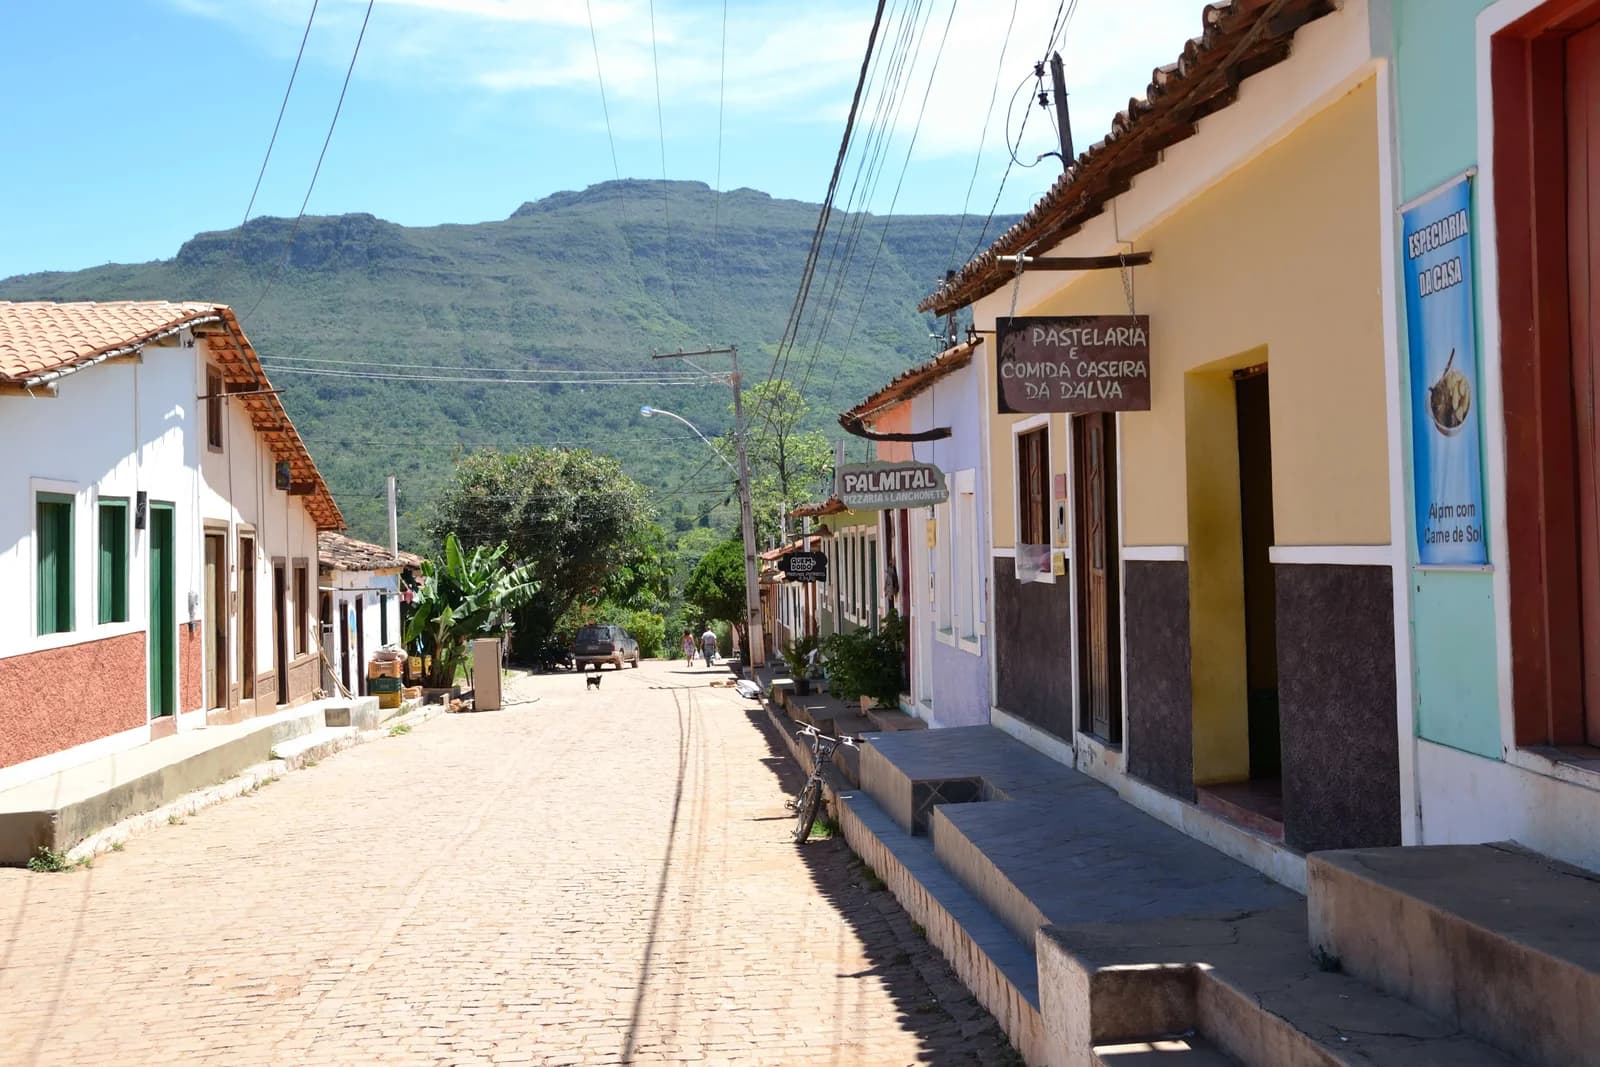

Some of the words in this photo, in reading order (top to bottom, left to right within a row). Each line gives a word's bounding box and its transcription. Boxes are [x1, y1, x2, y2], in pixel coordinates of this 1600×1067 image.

[1408, 208, 1468, 260] ESPECIARIA
[1419, 269, 1433, 298] DA
[1432, 256, 1463, 292] CASA
[1033, 327, 1146, 346] PASTELARIA
[1069, 347, 1079, 359] E
[1001, 362, 1071, 378] COMIDA
[1077, 360, 1147, 378] CASEIRA
[1025, 382, 1050, 400] DA
[844, 468, 936, 492] PALMITAL
[844, 493, 883, 505] PIZZARIA
[891, 489, 947, 502] LANCHONETE
[1456, 503, 1475, 517] com
[1424, 527, 1450, 544] Carne
[1452, 525, 1463, 543] de
[1466, 524, 1482, 543] Sol
